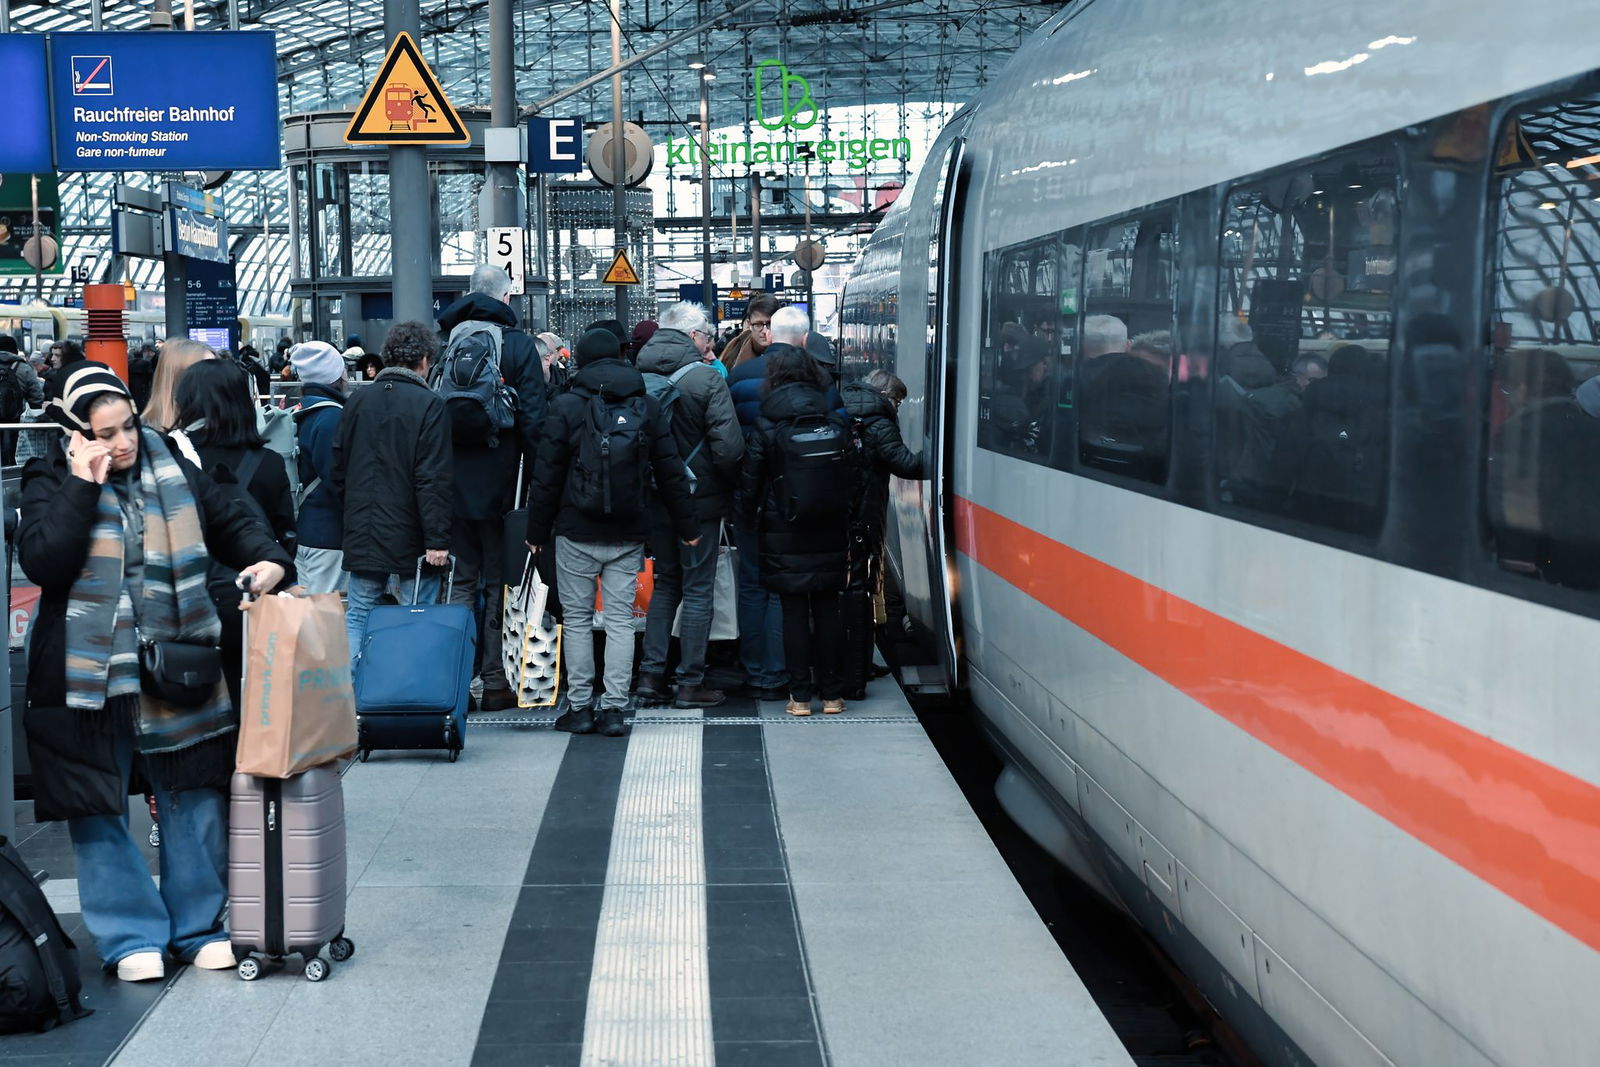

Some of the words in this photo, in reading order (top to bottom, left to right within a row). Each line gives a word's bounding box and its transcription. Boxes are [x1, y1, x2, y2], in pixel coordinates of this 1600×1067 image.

[73, 106, 165, 123] Rauchfreier
[169, 105, 235, 122] Bahnhof
[75, 130, 148, 144] Non-Smoking
[150, 130, 189, 142] Station
[549, 119, 576, 160] E
[76, 146, 102, 158] Gare
[104, 146, 167, 158] non-fumeur
[497, 232, 513, 257] 5
[73, 266, 89, 280] 15
[187, 280, 202, 288] 5-6
[772, 273, 783, 289] F
[433, 299, 441, 311] 4
